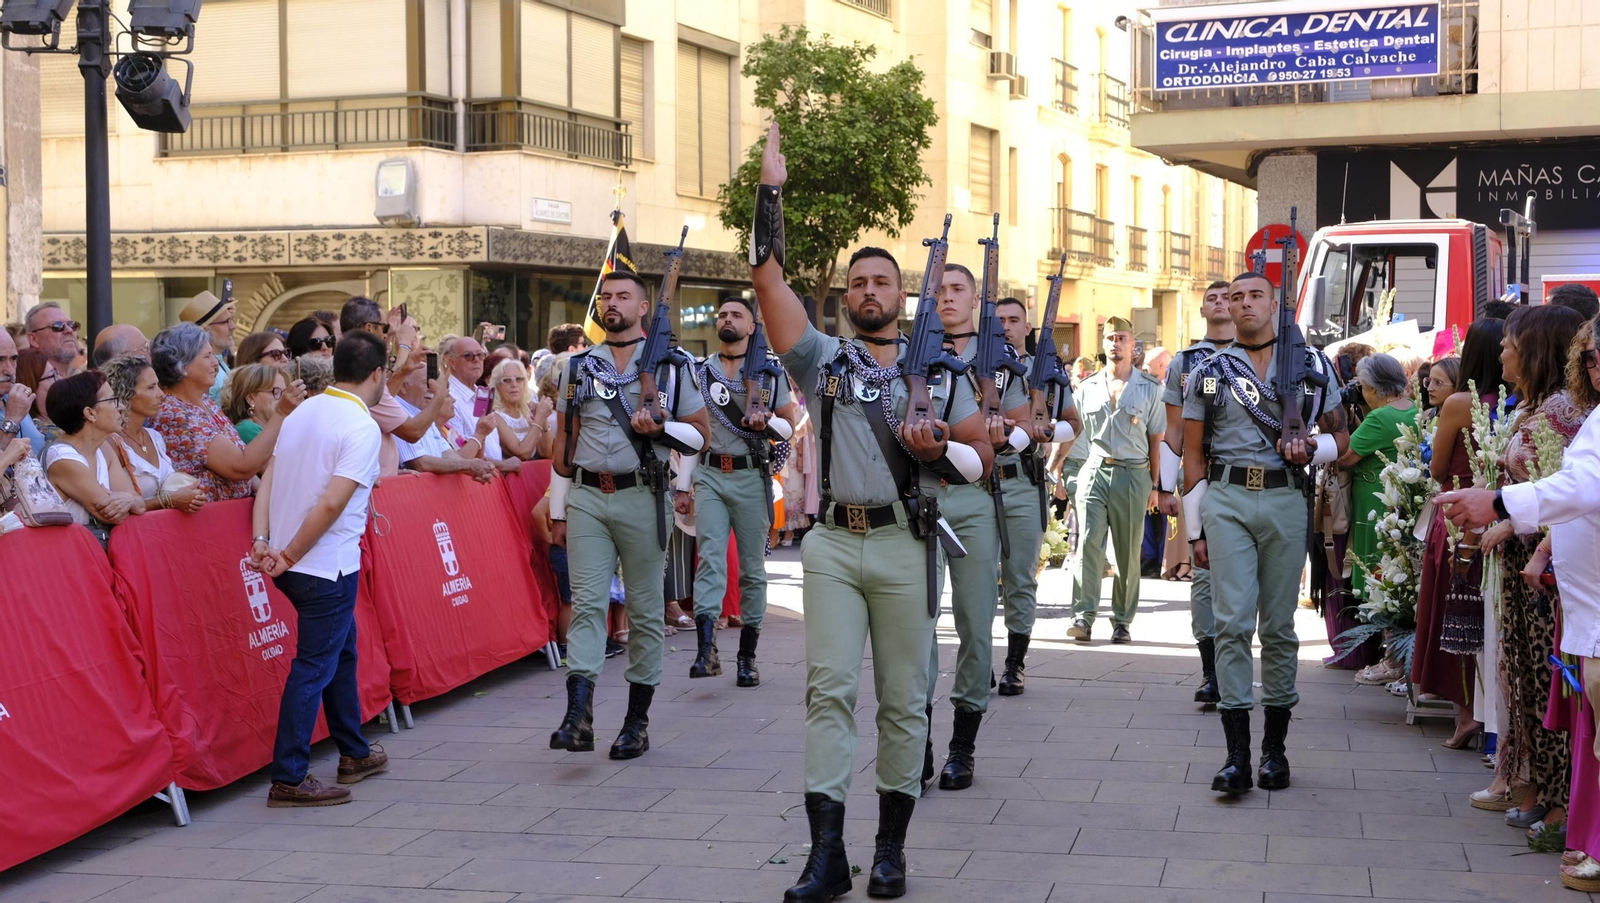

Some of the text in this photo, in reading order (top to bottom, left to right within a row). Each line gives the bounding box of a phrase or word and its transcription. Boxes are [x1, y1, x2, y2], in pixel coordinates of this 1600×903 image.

[1165, 7, 1429, 43] CLINICA DENTAL
[1160, 47, 1212, 60] Cirugía
[1226, 43, 1300, 57] Implantes
[1314, 38, 1378, 50] Estetica
[1384, 33, 1435, 46] Dental
[1209, 59, 1286, 73] Alejandro
[1295, 56, 1336, 67] Caba
[1342, 51, 1416, 65] Calvache
[1163, 73, 1258, 86] ORTODONCIA
[1478, 163, 1600, 187] MAÑAS C
[1478, 187, 1600, 202] INMOBILI
[249, 272, 285, 312] MAR
[442, 574, 473, 597] ALMERÍA
[249, 618, 289, 650] ALMERÍA
